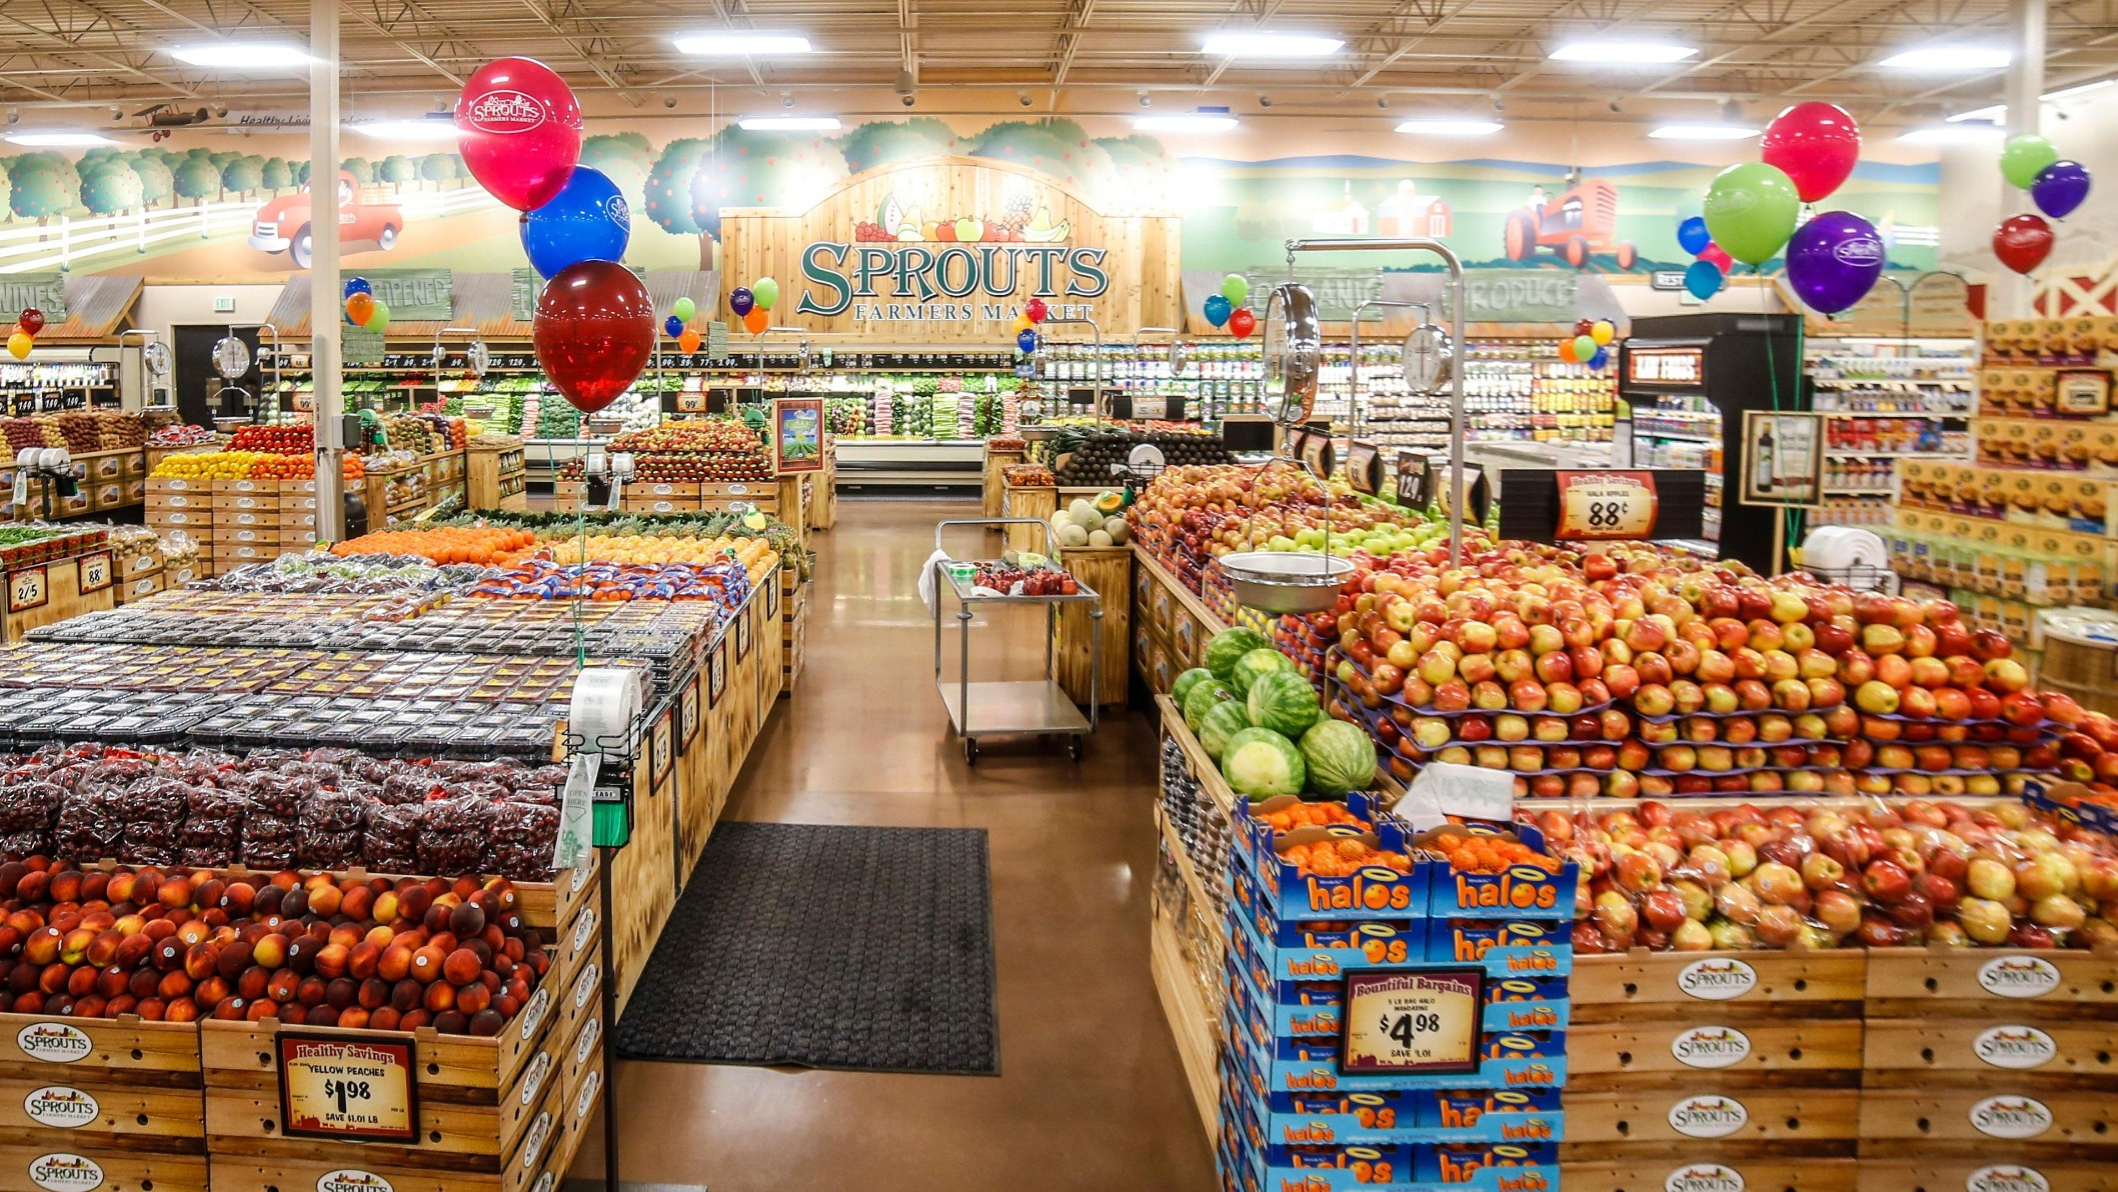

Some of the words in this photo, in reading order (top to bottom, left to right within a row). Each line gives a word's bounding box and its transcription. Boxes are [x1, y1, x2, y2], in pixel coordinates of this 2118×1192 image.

[474, 105, 540, 122] SPROUTS
[240, 115, 285, 130] Healthy
[796, 240, 1110, 316] SPROUTS
[1658, 273, 1685, 286] REST
[1255, 279, 1382, 307] OANIC
[1464, 280, 1574, 309] RODUCE
[853, 303, 973, 321] FARMERS
[982, 303, 1092, 321] MAKET
[1589, 501, 1628, 526] 88¢
[1307, 872, 1411, 911] halos
[1456, 872, 1557, 909] halos
[1288, 956, 1339, 976] halos
[1507, 953, 1557, 972] halos
[1685, 973, 1750, 989] SPROUTS
[1984, 970, 2054, 986] SPROUTS
[1355, 977, 1414, 998] Bountiful
[1416, 977, 1472, 997] Bargains
[1290, 1015, 1340, 1034] halos
[1509, 1009, 1557, 1028] halos
[24, 1035, 87, 1050] SPROUTS
[1678, 1041, 1744, 1058] SPROUTS
[1981, 1040, 2050, 1056] SPROUTS
[297, 1045, 343, 1059] Healthy
[347, 1045, 394, 1064] Savings
[1391, 1050, 1411, 1058] SAVE
[308, 1064, 343, 1075] YELLOW
[347, 1066, 385, 1077] PEACHES
[1504, 1065, 1554, 1085] halos
[1286, 1071, 1337, 1089] halos
[31, 1100, 93, 1115] SPROUTS
[325, 1113, 344, 1121] SAVE
[347, 1114, 365, 1123] $1.01
[368, 1115, 378, 1123] LB
[1675, 1111, 1742, 1127] SPROUTS
[1977, 1110, 2047, 1126] SPROUTS
[1283, 1124, 1334, 1143] halos
[1502, 1121, 1551, 1139] halos
[36, 1166, 98, 1182] SPROUTS
[1281, 1177, 1331, 1192] halos
[1498, 1175, 1548, 1192] halos
[1672, 1179, 1738, 1192] SPROUTS
[1975, 1178, 2044, 1192] SPROUTS
